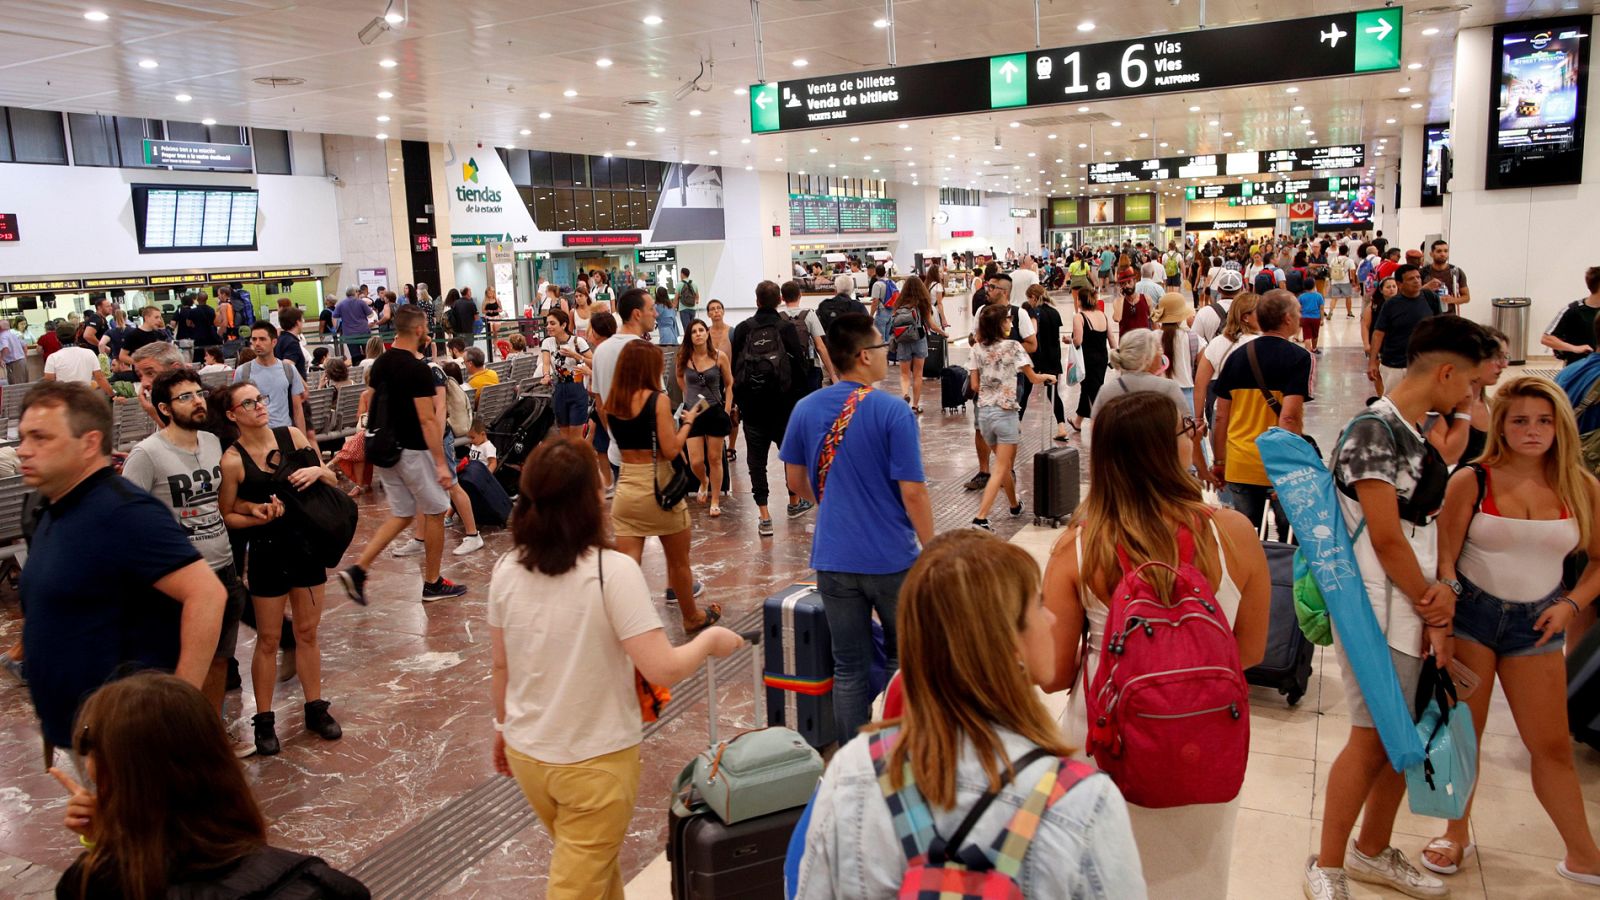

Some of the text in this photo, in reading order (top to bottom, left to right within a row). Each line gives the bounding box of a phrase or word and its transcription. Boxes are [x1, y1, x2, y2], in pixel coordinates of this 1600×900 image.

[1154, 40, 1182, 55] Vías
[1063, 43, 1148, 94] 1 a 6
[1154, 58, 1182, 72] Vies
[807, 76, 896, 95] Venta de billetes
[1154, 73, 1200, 86] PLATFORMS
[807, 90, 899, 110] Venda de bitllets
[807, 110, 847, 121] TICKETS SALE
[456, 185, 502, 202] tiendas
[465, 205, 503, 213] de la estación
